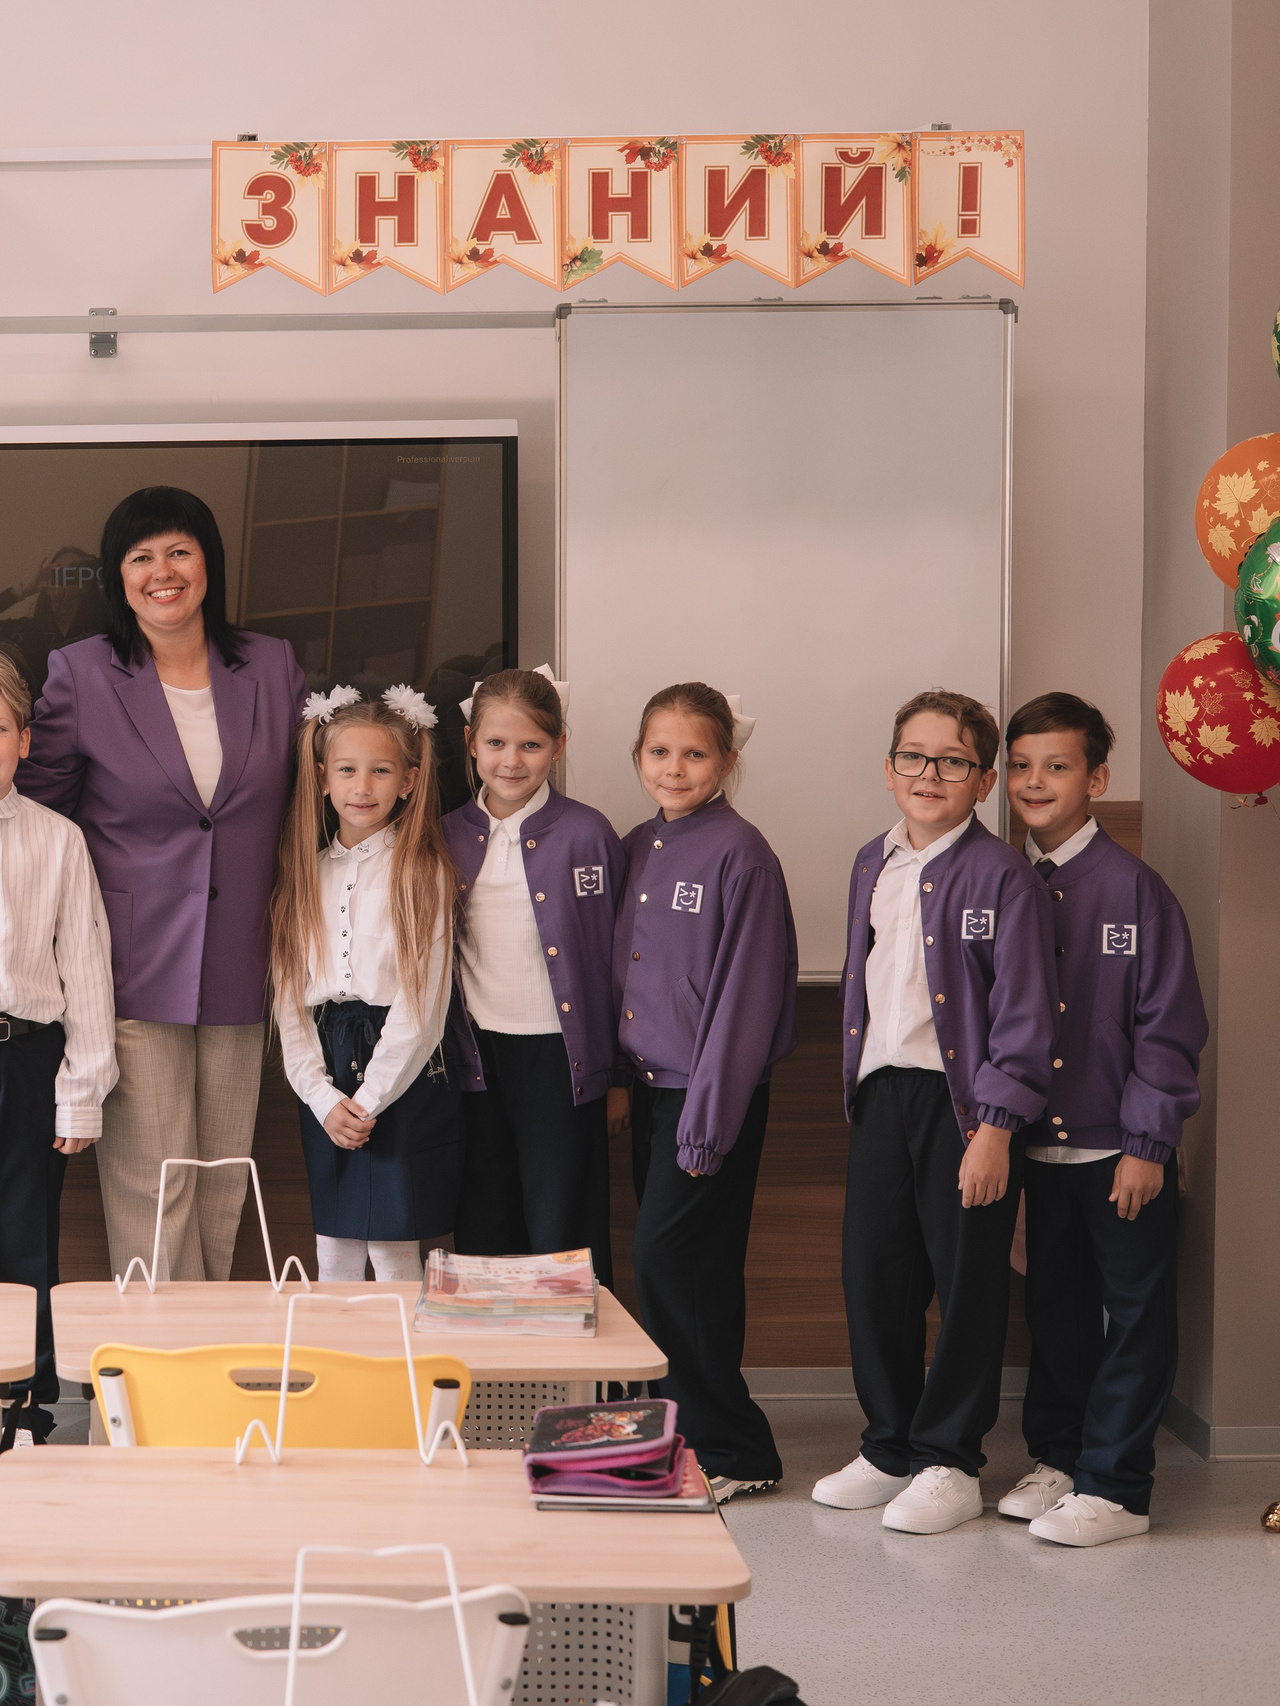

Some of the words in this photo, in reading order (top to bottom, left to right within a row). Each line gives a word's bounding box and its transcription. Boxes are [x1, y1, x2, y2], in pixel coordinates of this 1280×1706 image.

[240, 145, 983, 249] ЗНАНИЙ!
[397, 455, 448, 464] Professional
[450, 455, 481, 463] version
